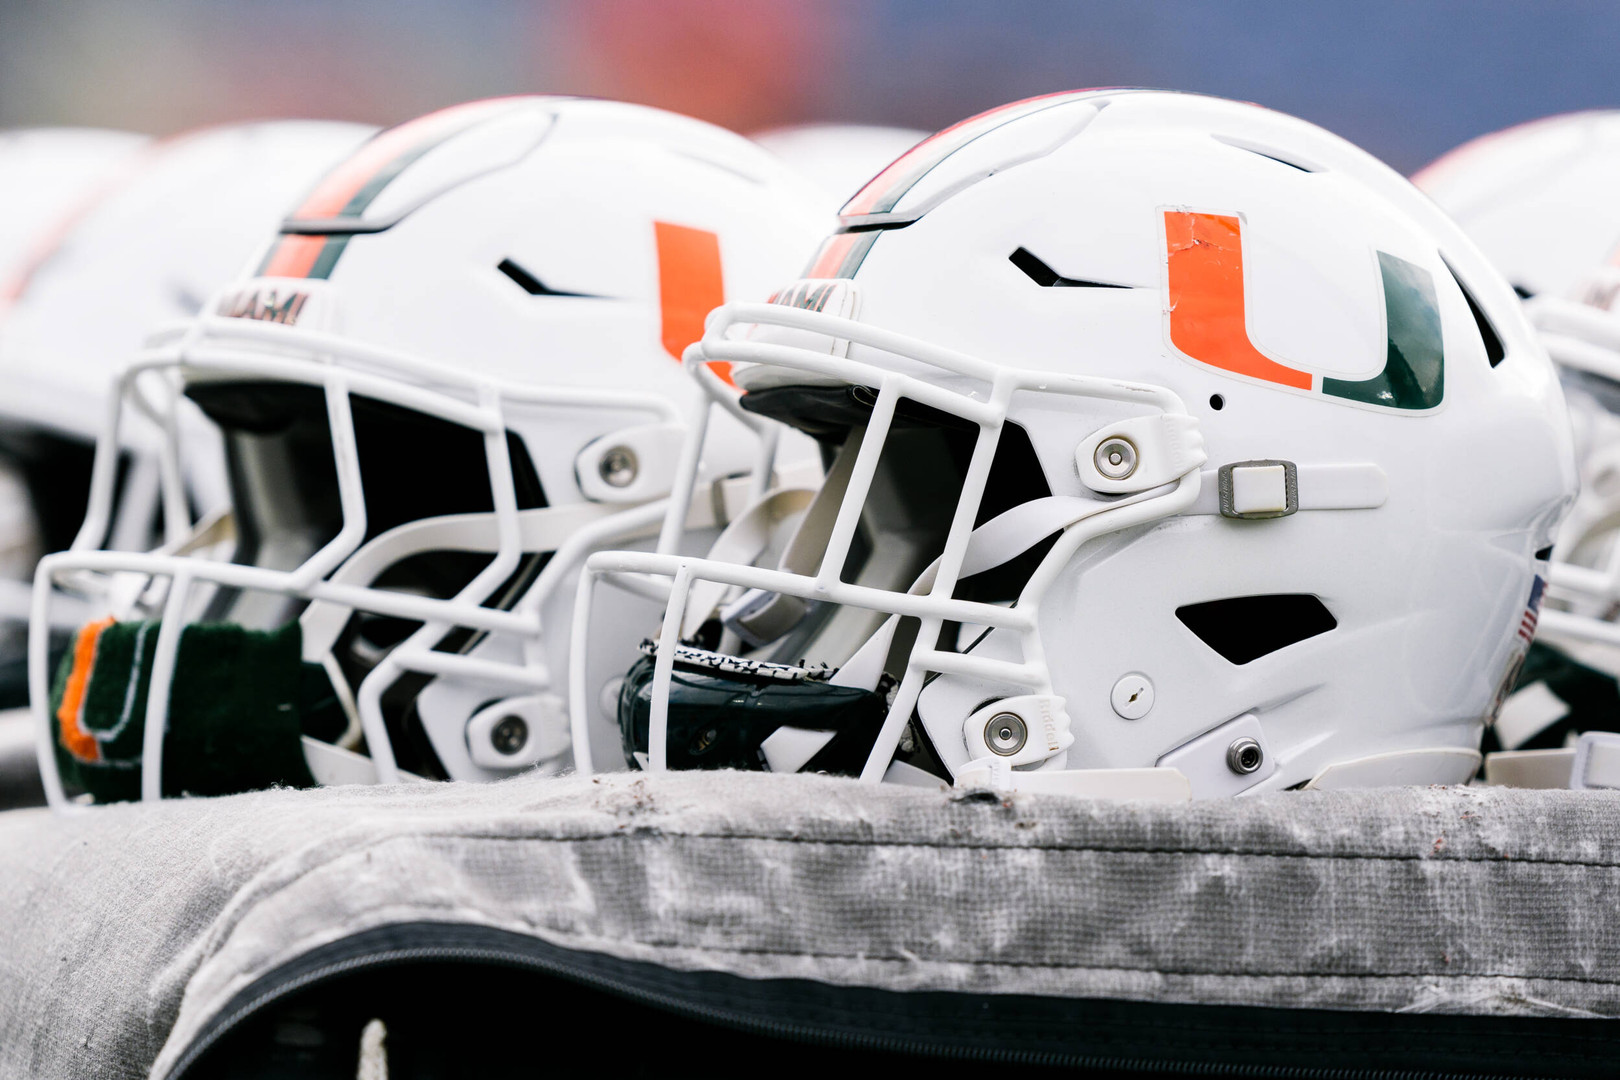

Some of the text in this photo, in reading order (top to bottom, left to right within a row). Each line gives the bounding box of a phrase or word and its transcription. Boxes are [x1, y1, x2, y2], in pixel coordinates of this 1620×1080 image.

[765, 283, 838, 314] IAMI
[1163, 210, 1446, 411] U
[1039, 699, 1059, 752] Riddell
